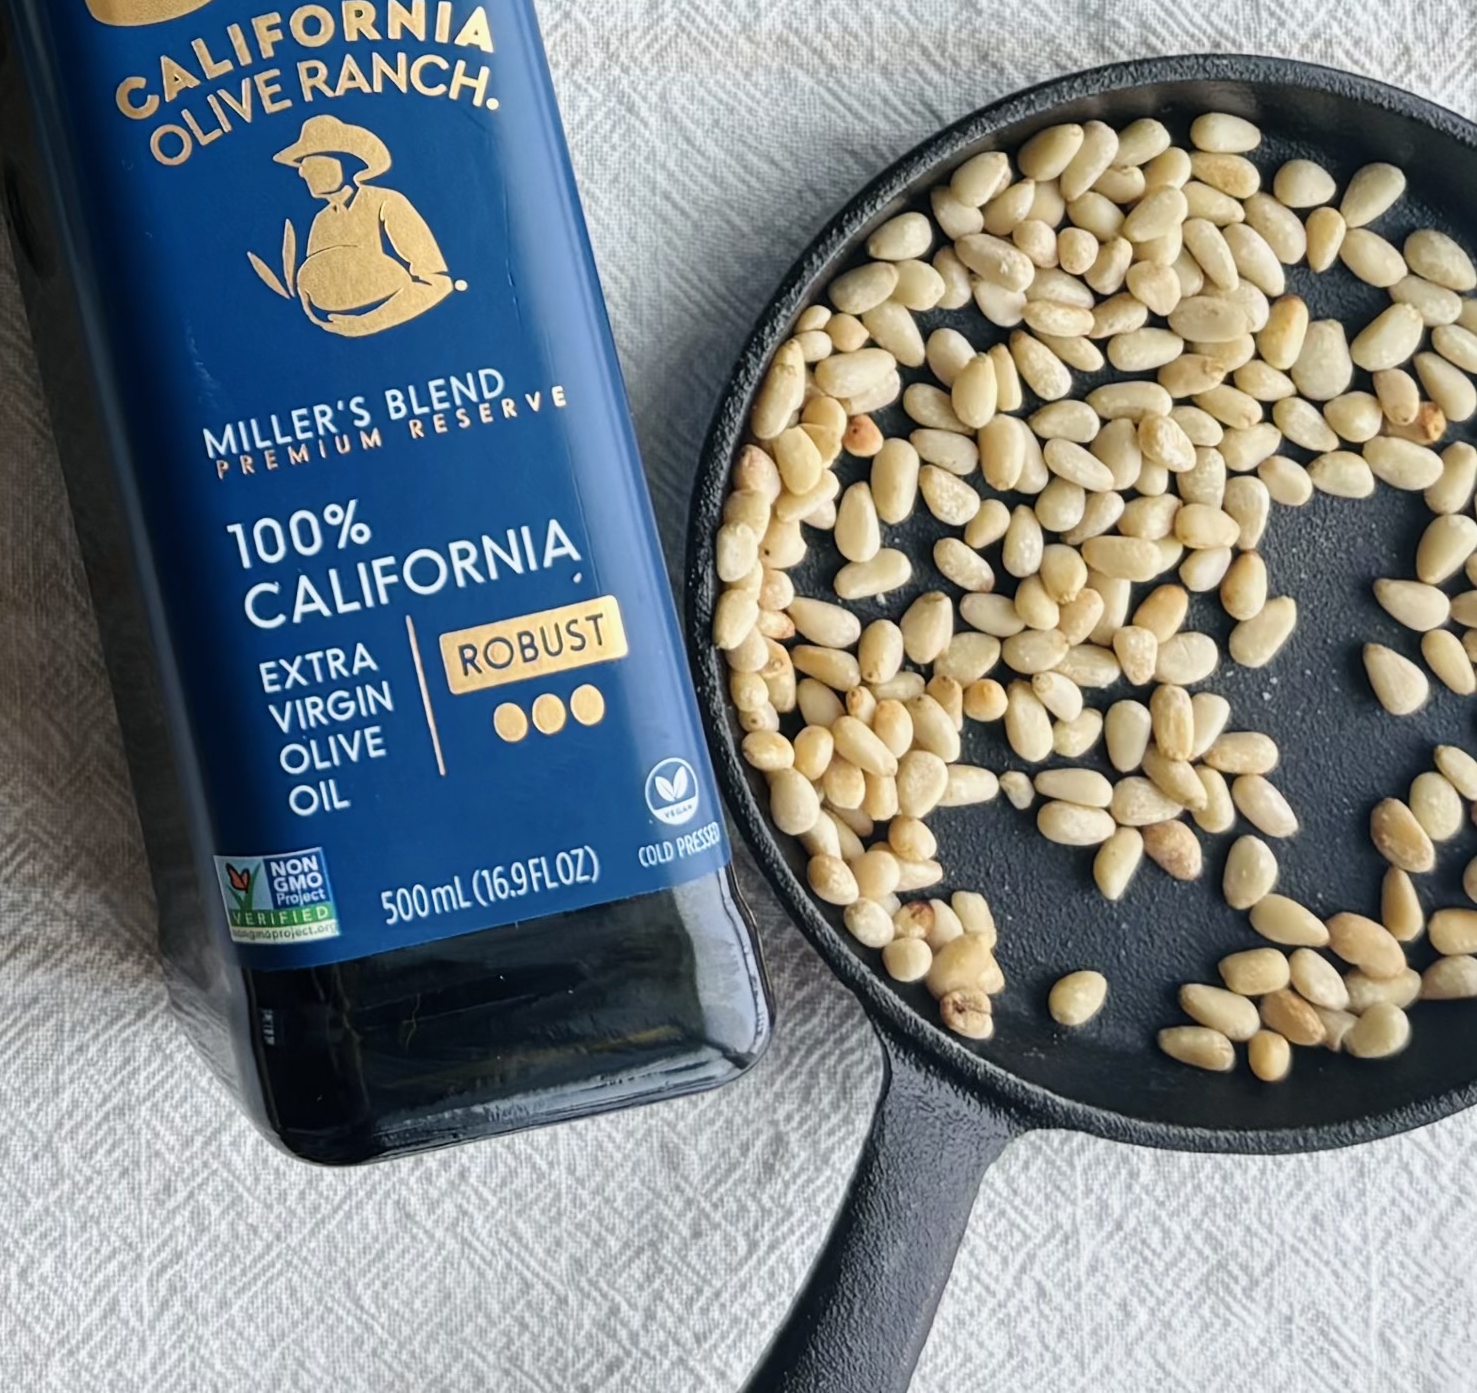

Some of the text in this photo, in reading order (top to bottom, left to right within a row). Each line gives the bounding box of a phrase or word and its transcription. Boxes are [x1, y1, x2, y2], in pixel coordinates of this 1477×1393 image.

[115, 0, 495, 121] CALIFORNIA
[149, 69, 292, 166] OLIVE
[203, 368, 505, 459] MILLER'S BLEND
[216, 386, 567, 479] PREMIUM RESERVE
[227, 498, 372, 570] 100%
[245, 518, 581, 629] CALIFORNIA
[259, 642, 378, 694] EXTRA
[460, 614, 605, 676] ROBUST
[269, 681, 394, 734] VIRGIN
[280, 726, 387, 775] OLIVE
[288, 779, 350, 816] OIL
[270, 854, 318, 876] NON
[639, 821, 721, 868] COLD PRESSED
[274, 871, 323, 893] GMO
[277, 888, 326, 906] Project
[232, 905, 329, 925] VERIFIED
